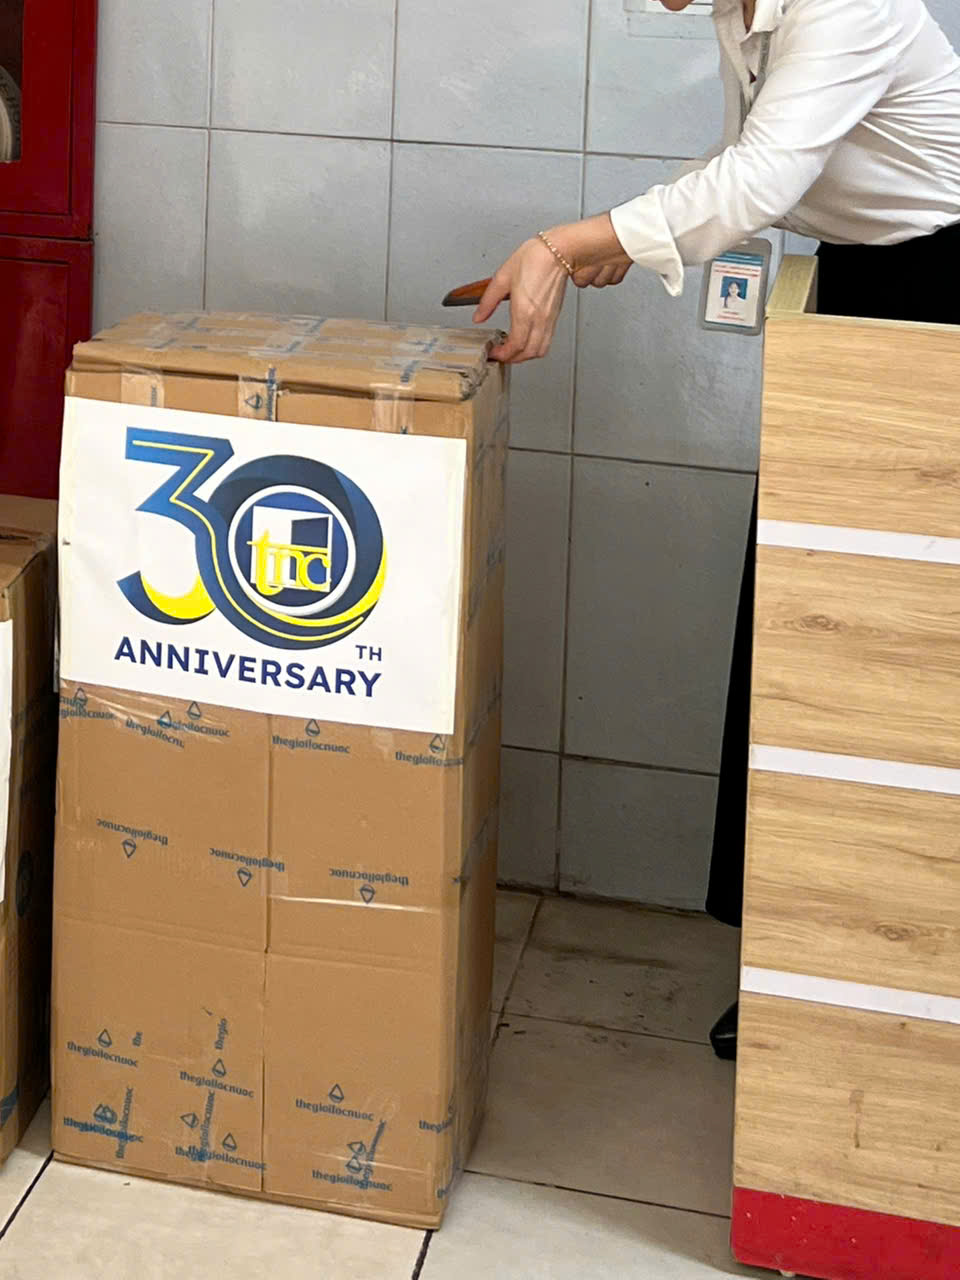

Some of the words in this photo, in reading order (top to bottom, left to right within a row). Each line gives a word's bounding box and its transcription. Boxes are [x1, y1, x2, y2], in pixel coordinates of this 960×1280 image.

[116, 426, 388, 651] 30
[114, 636, 382, 698] ANNIVERSARY
[355, 645, 382, 662] TH
[295, 1098, 375, 1121] thegioilocnuoc
